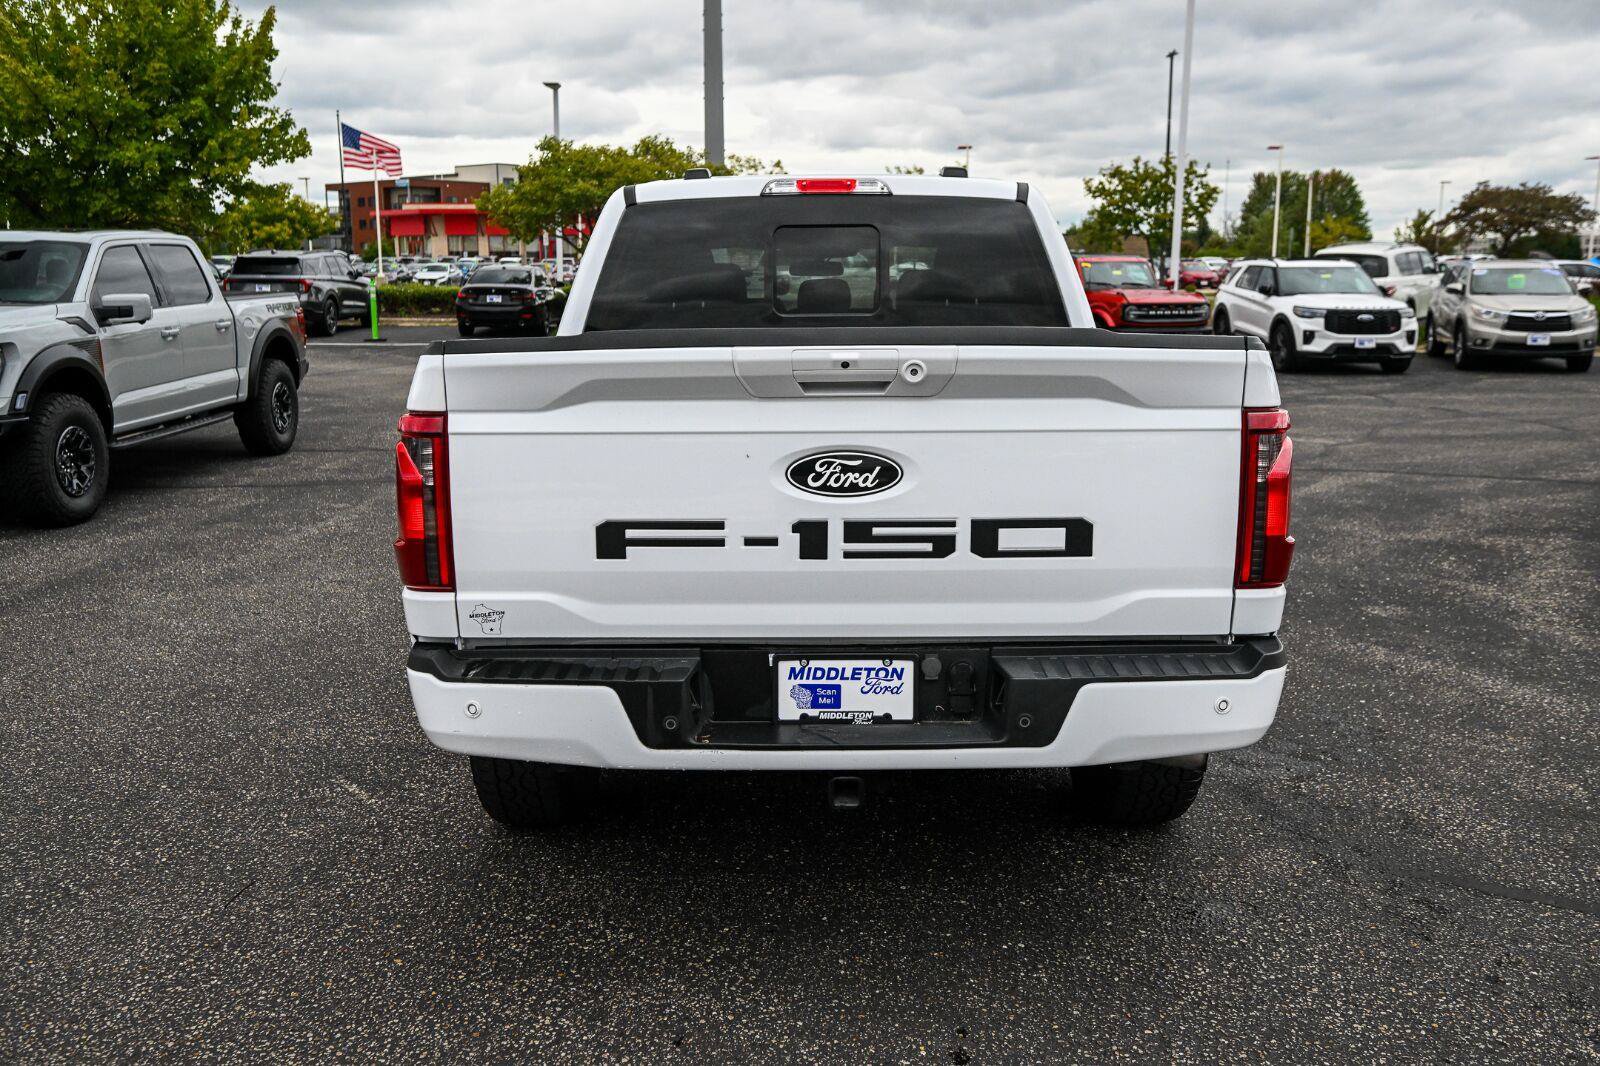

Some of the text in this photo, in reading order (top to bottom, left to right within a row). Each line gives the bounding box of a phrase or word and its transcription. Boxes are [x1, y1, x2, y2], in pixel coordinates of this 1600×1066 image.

[807, 457, 880, 489] Ford
[595, 518, 1094, 560] F-150
[469, 610, 505, 618] MIDDLETON
[787, 666, 905, 681] MIDDLETON
[816, 687, 837, 696] Scan
[860, 677, 905, 695] Ford
[819, 712, 873, 720] MIDDLETON
